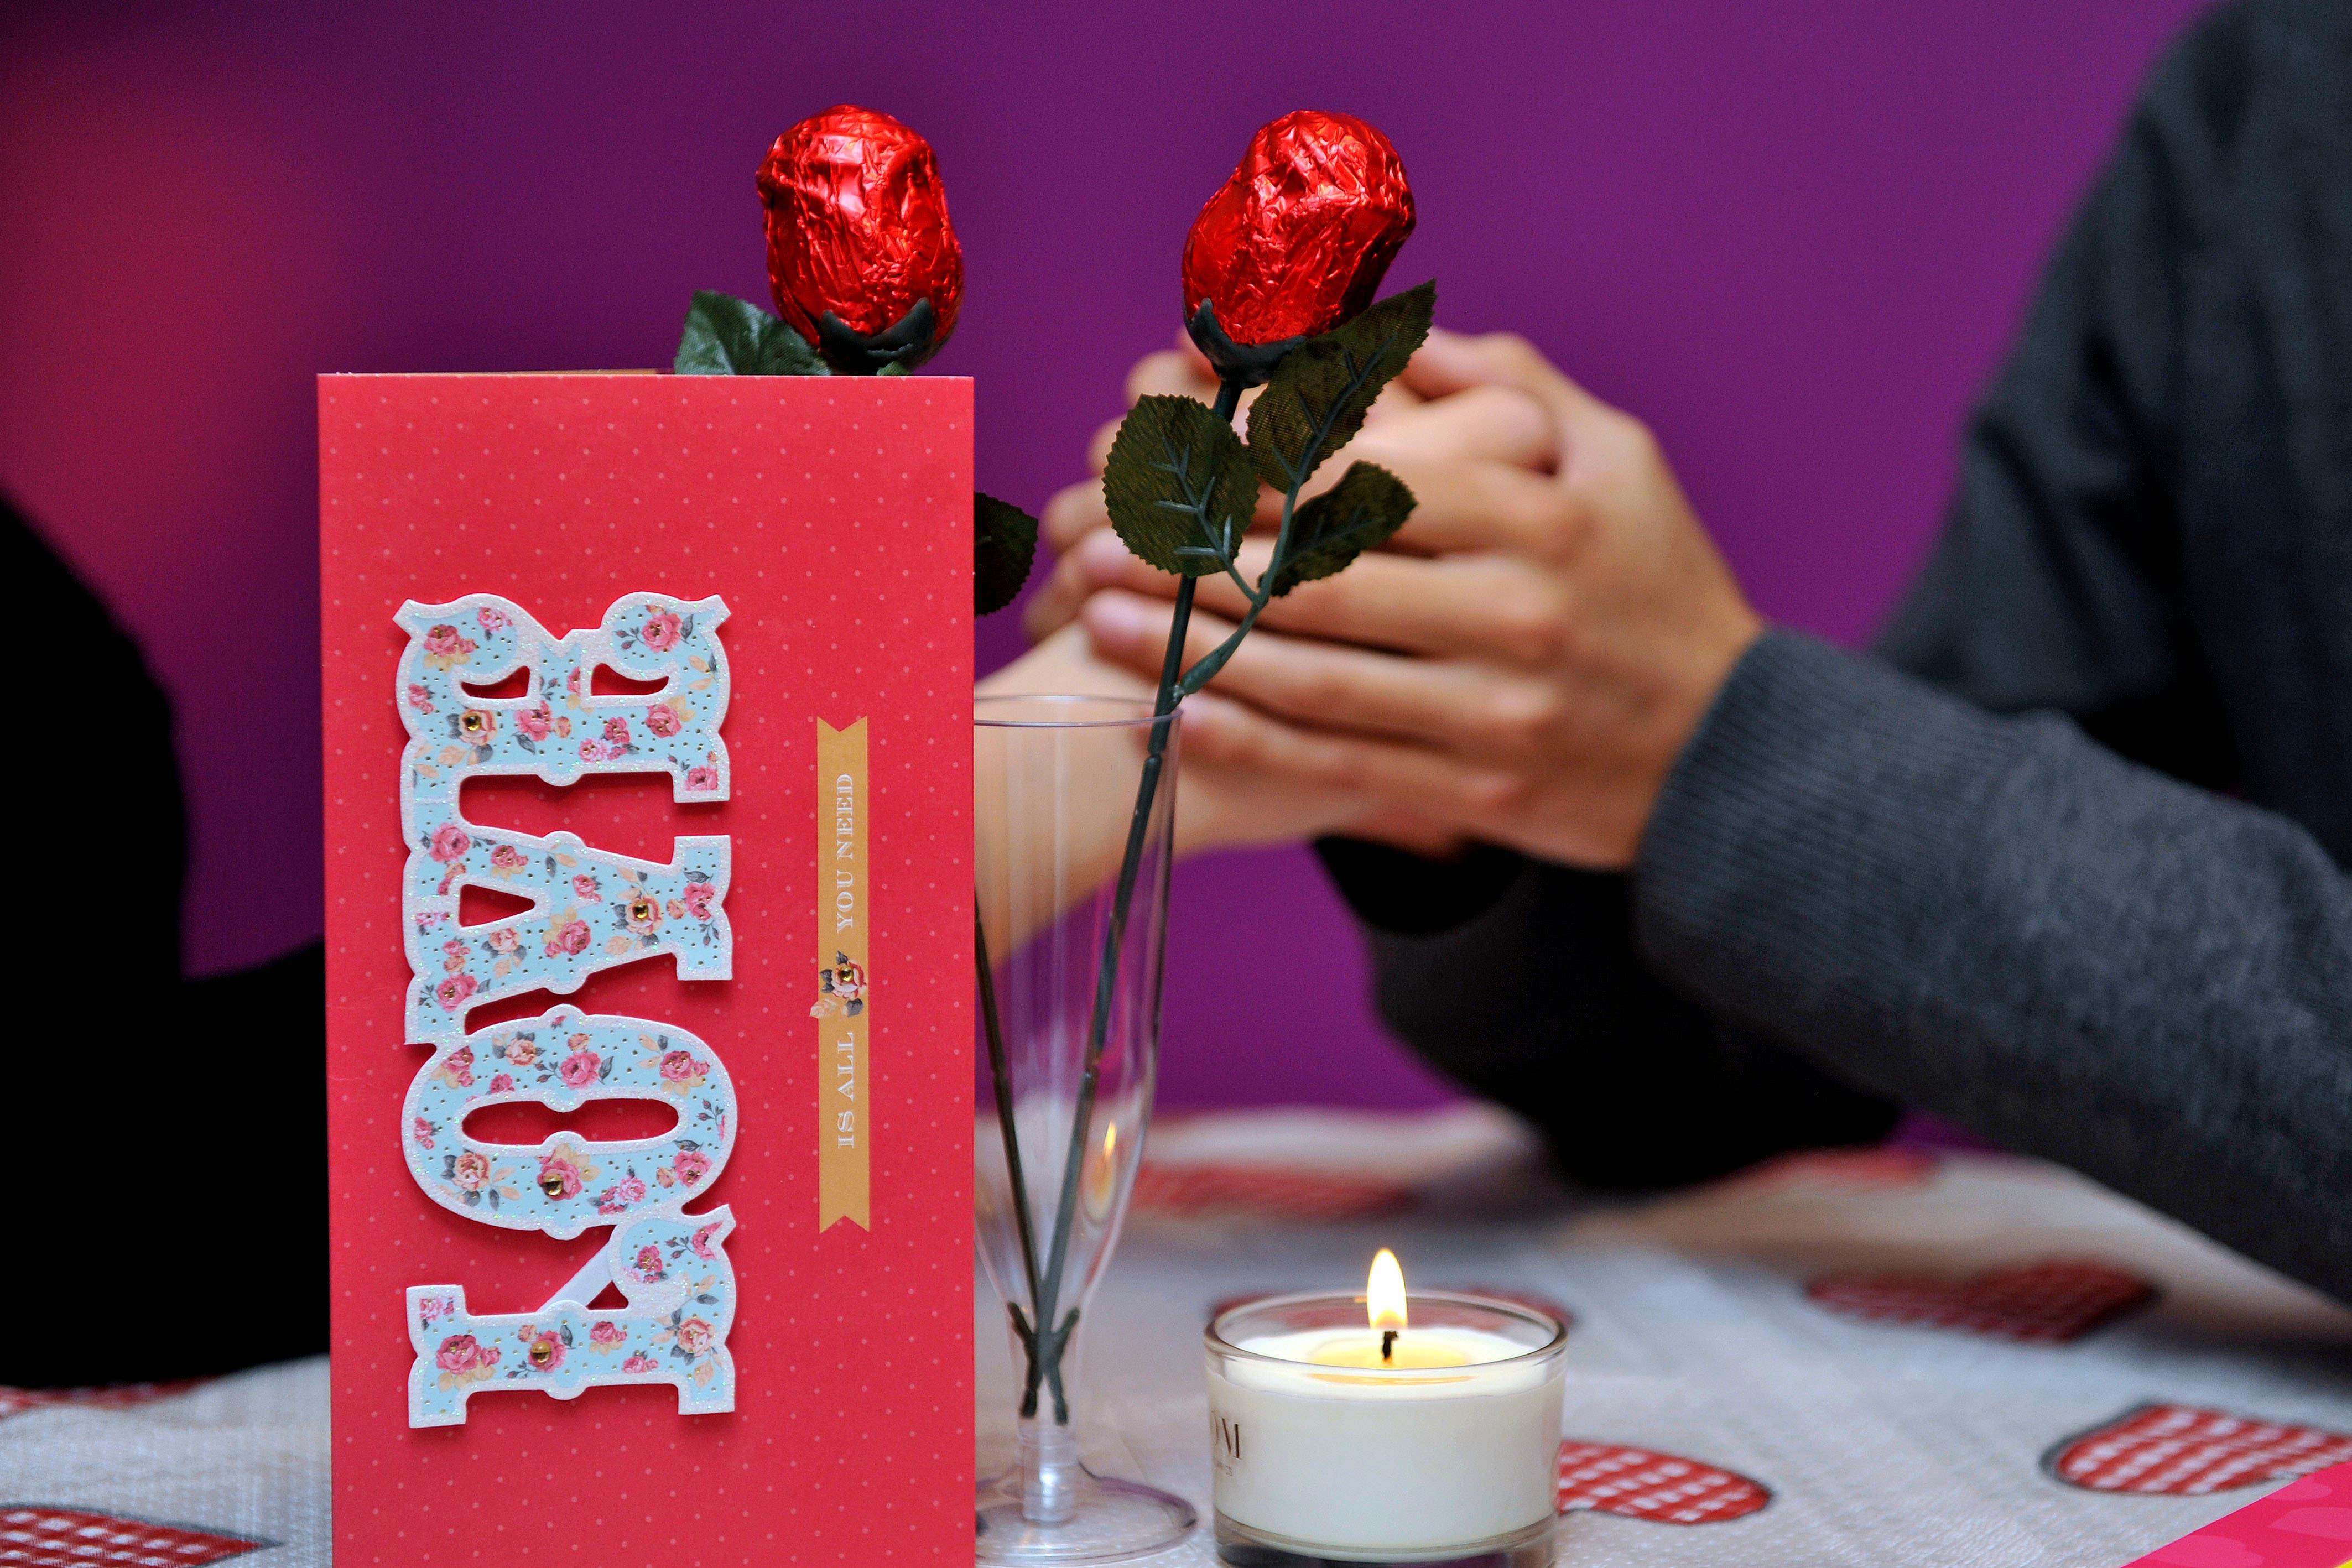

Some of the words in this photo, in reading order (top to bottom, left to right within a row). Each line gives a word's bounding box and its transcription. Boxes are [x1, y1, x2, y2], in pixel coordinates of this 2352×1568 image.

[836, 774, 854, 861] NEED
[836, 870, 854, 934] YOU
[393, 591, 738, 1428] LOVE
[837, 1031, 855, 1102] ALL
[837, 1110, 854, 1149] IS
